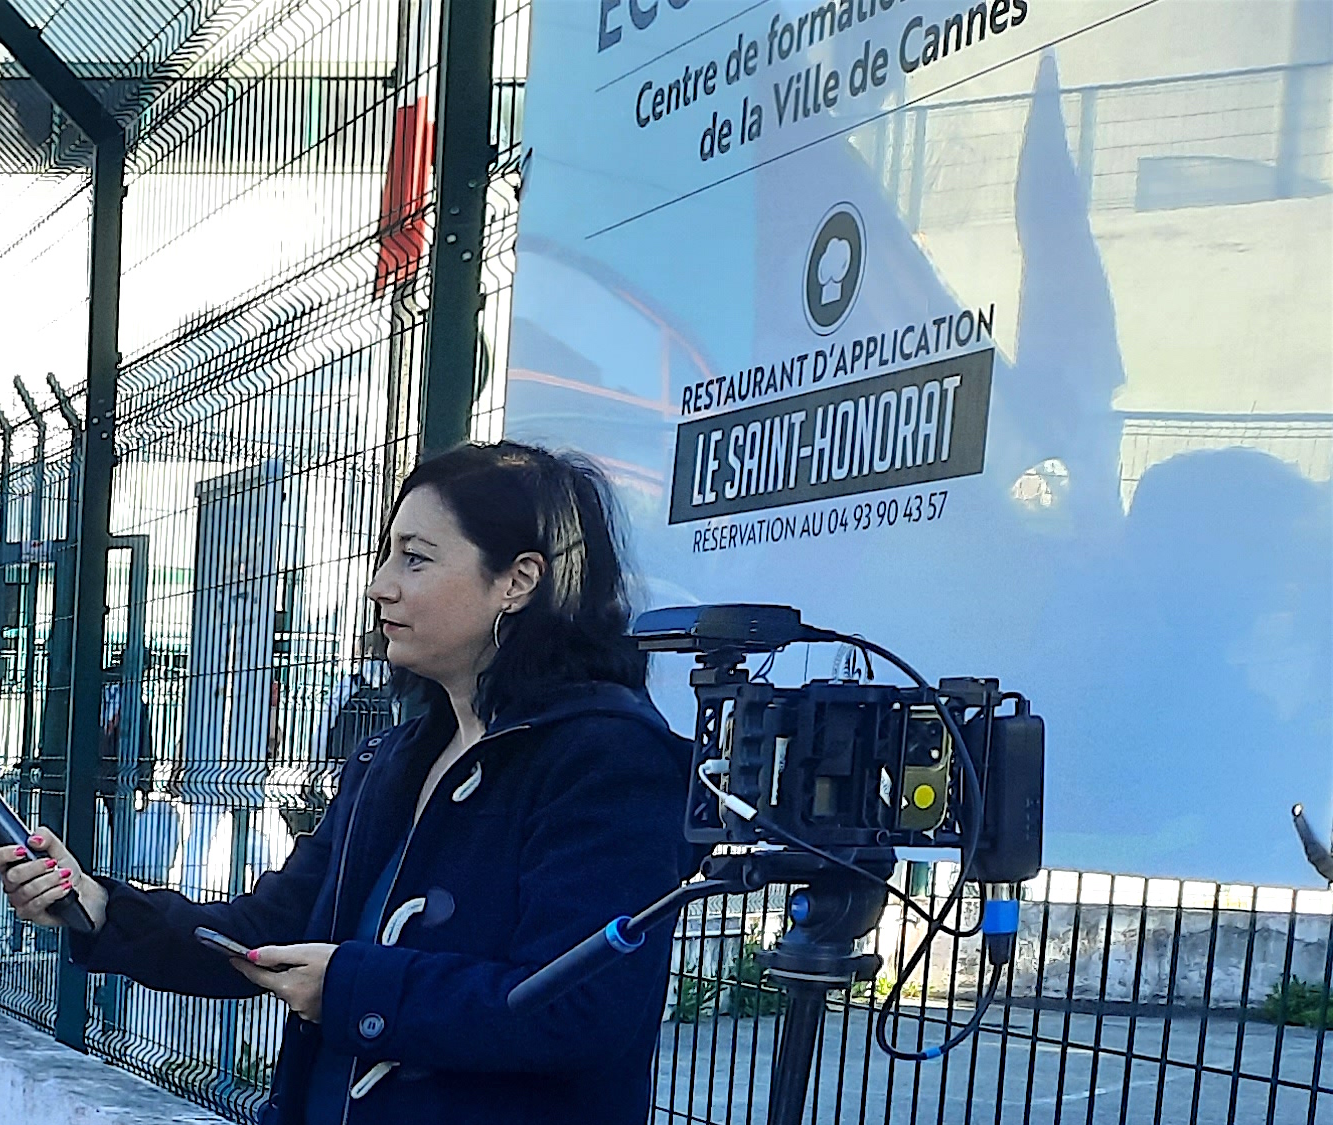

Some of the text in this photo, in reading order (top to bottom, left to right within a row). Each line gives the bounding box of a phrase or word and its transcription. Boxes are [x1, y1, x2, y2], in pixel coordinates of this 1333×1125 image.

[636, 61, 718, 128] Centre
[726, 33, 758, 86] de
[700, 0, 1028, 162] de la Ville de Cannes
[681, 303, 995, 416] RESTAURANT D'APPLICATION
[691, 374, 963, 507] LE SAINT-HONORAT
[692, 491, 948, 553] RÉSERVATION AU 04 93 90 43 57
